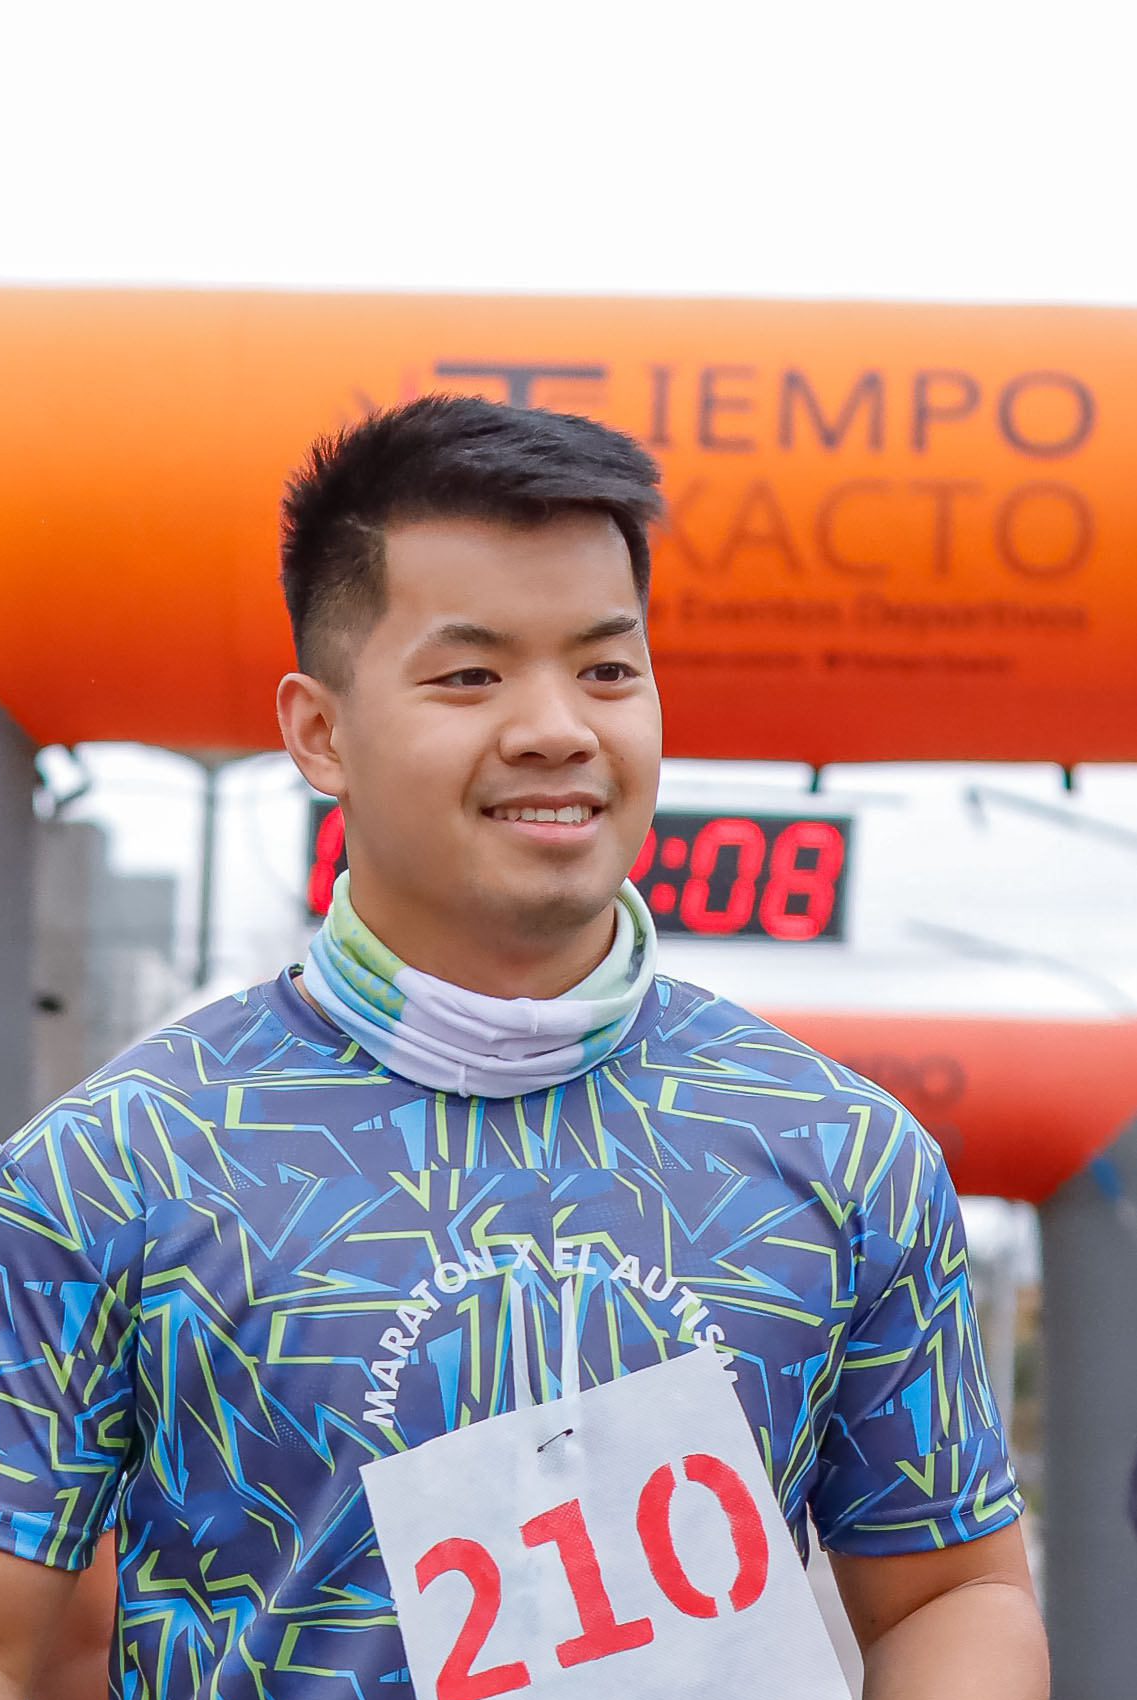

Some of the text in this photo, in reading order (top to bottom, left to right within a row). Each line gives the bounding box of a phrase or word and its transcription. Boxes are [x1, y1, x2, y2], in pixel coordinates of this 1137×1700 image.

[363, 1243, 498, 1429] MARATÓN
[510, 1239, 539, 1271] X
[553, 1239, 597, 1275] EL
